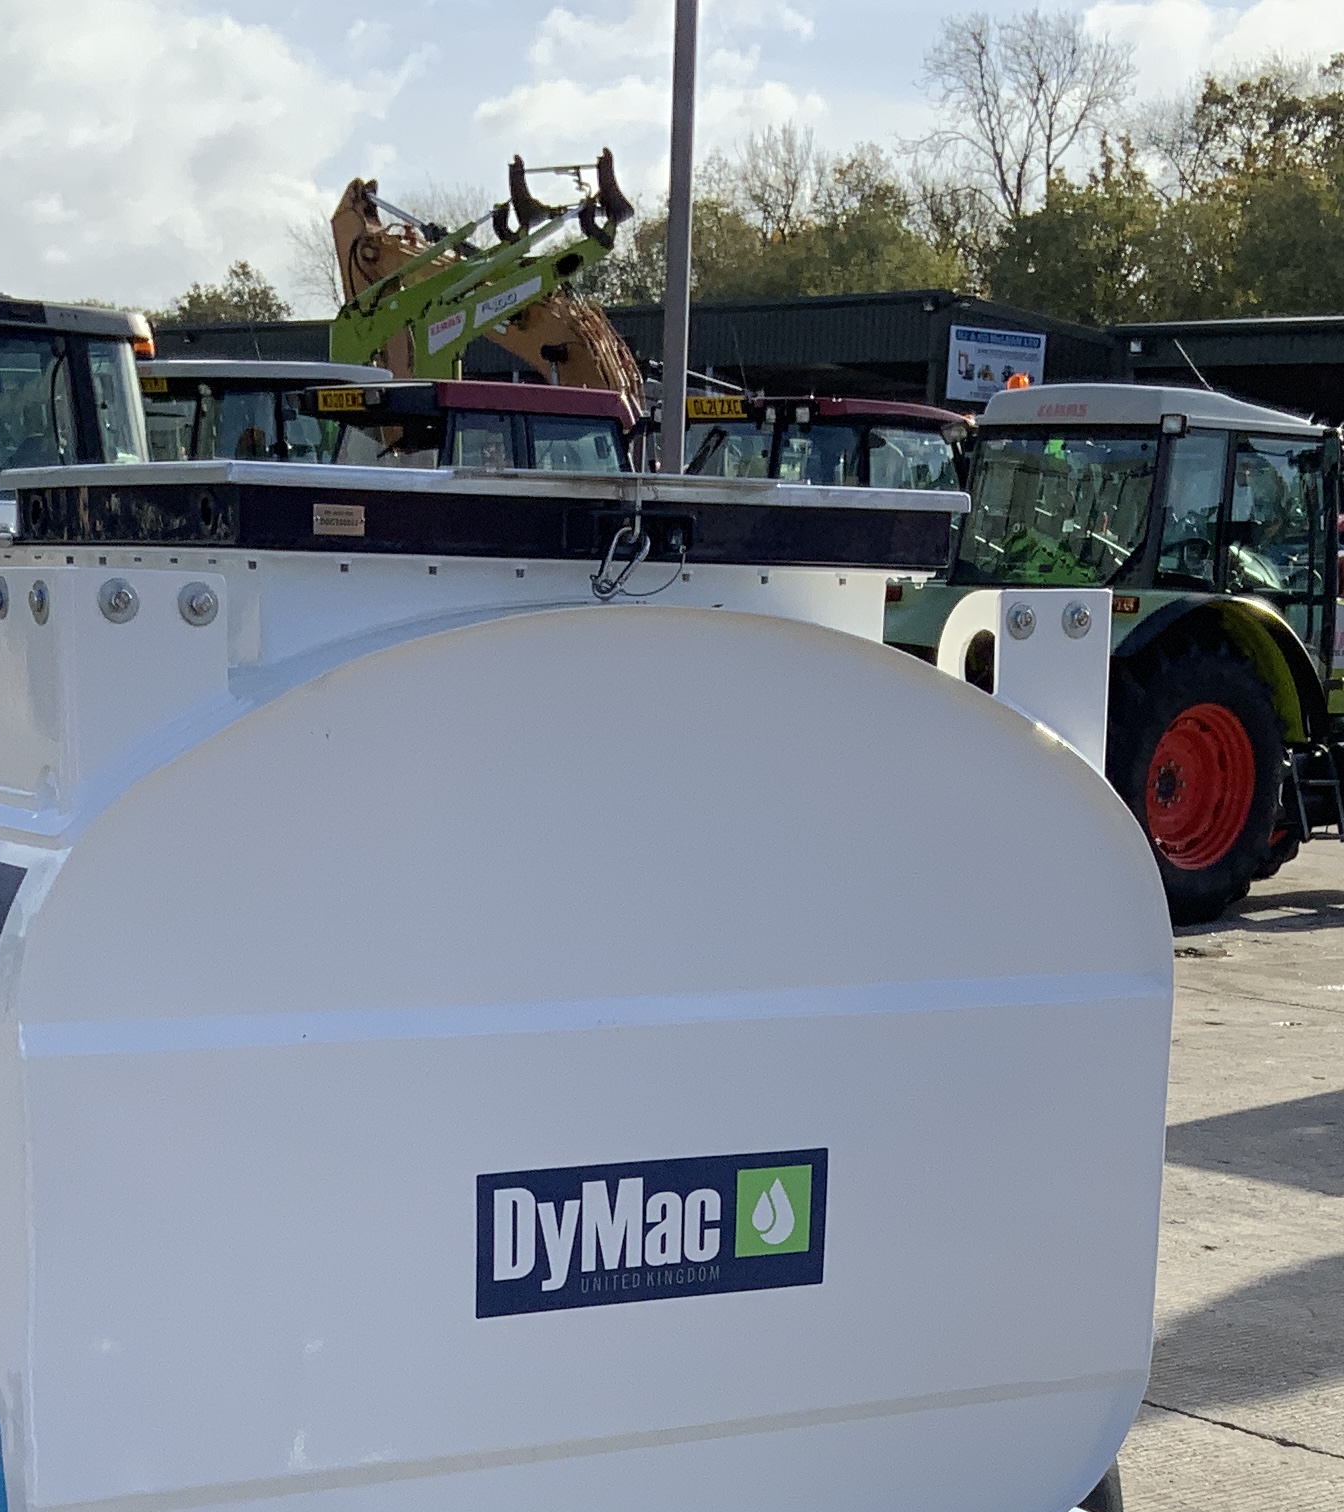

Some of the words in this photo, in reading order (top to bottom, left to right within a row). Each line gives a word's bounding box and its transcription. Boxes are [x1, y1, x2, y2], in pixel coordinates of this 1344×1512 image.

[493, 1176, 722, 1292] DyMac
[581, 1272, 641, 1294] UNITED
[646, 1265, 721, 1288] KINGDOM
